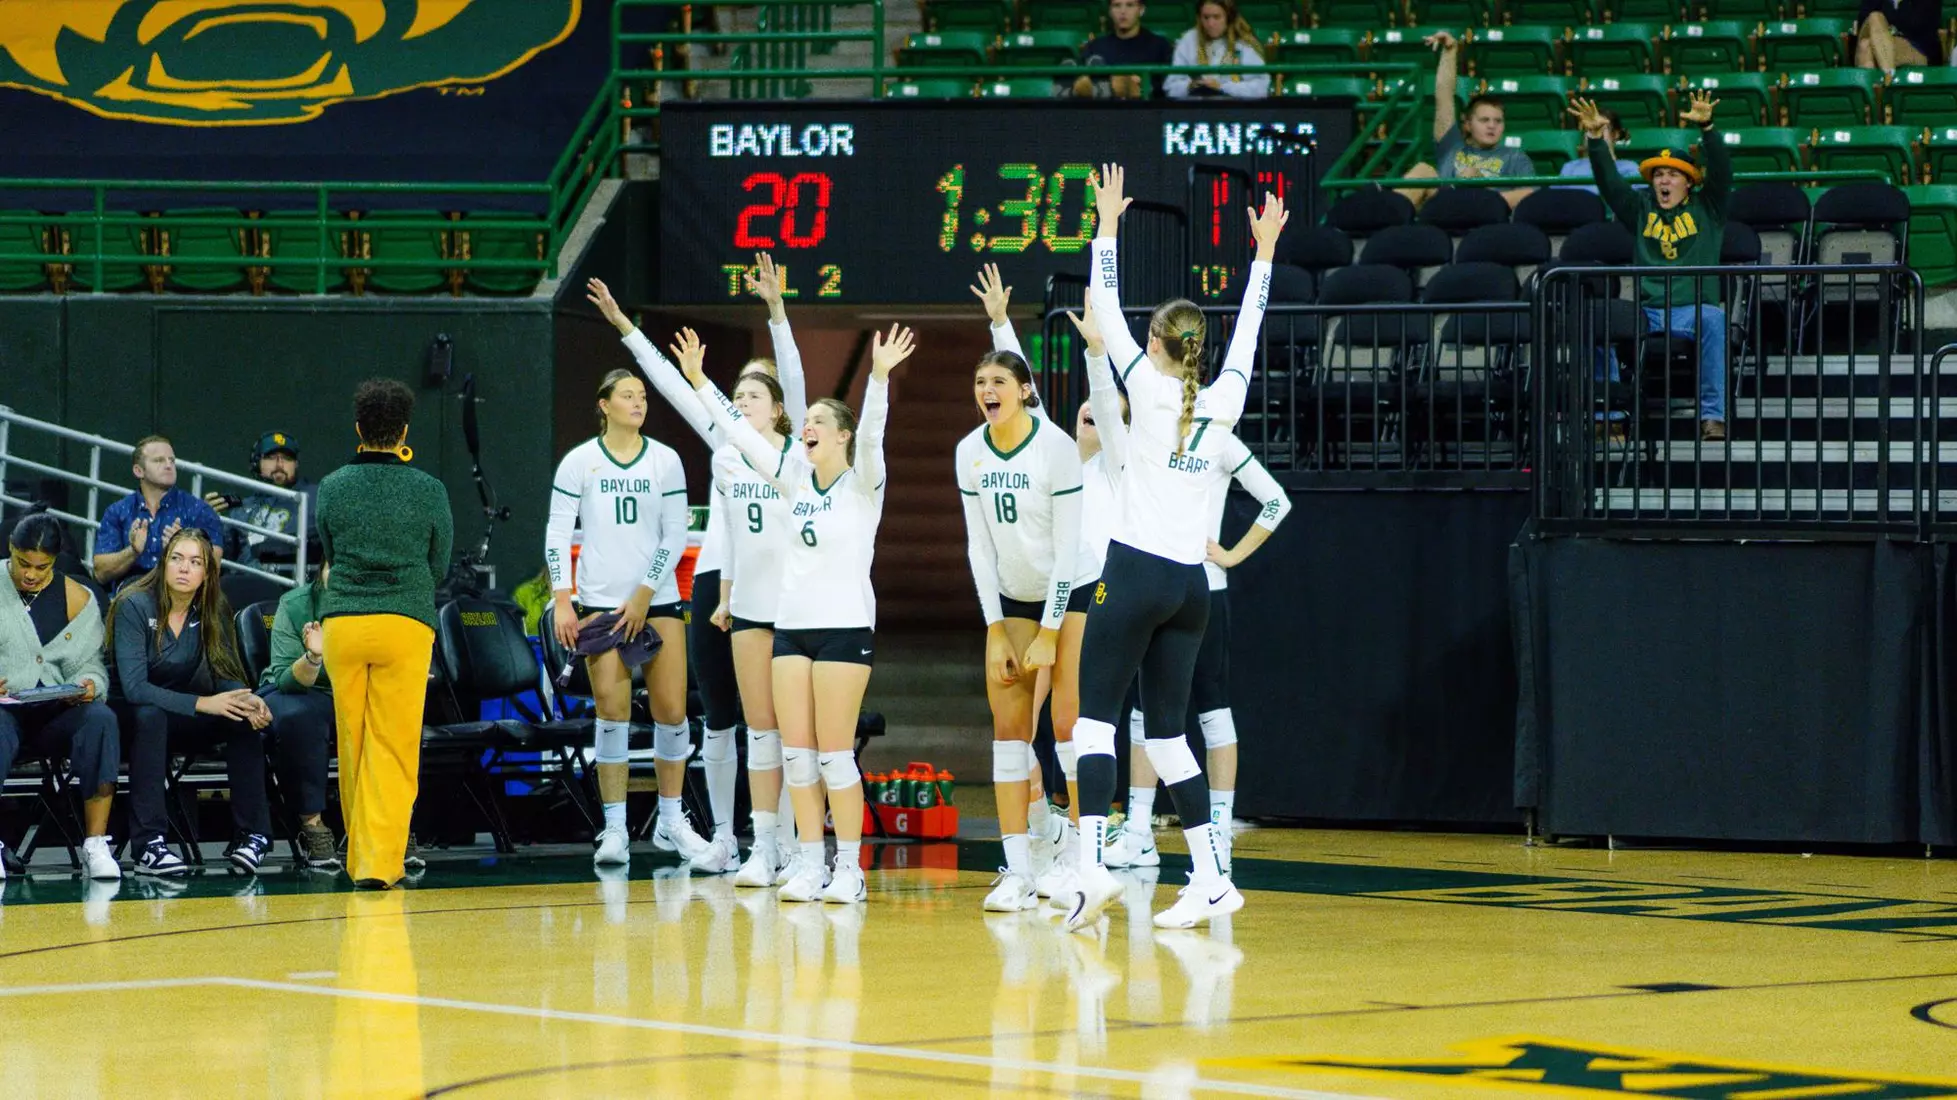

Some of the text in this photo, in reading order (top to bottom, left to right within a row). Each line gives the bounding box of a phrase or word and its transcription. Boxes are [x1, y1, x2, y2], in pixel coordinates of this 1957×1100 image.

[710, 123, 854, 156] BAYLOR
[734, 172, 833, 248] 20
[935, 163, 1101, 253] 1:30
[817, 263, 842, 297] 2
[1100, 249, 1117, 288] BEARS
[1168, 451, 1209, 474] BEARS
[601, 479, 651, 493] BAYLOR
[733, 483, 780, 500] BAYLOR
[981, 472, 1030, 490] BAYLOR
[616, 496, 638, 525] 10
[747, 503, 763, 533] 9
[994, 492, 1018, 524] 18
[801, 520, 817, 547] 6
[646, 548, 670, 581] BEARS
[1052, 581, 1071, 618] BEARS
[896, 813, 908, 833] G
